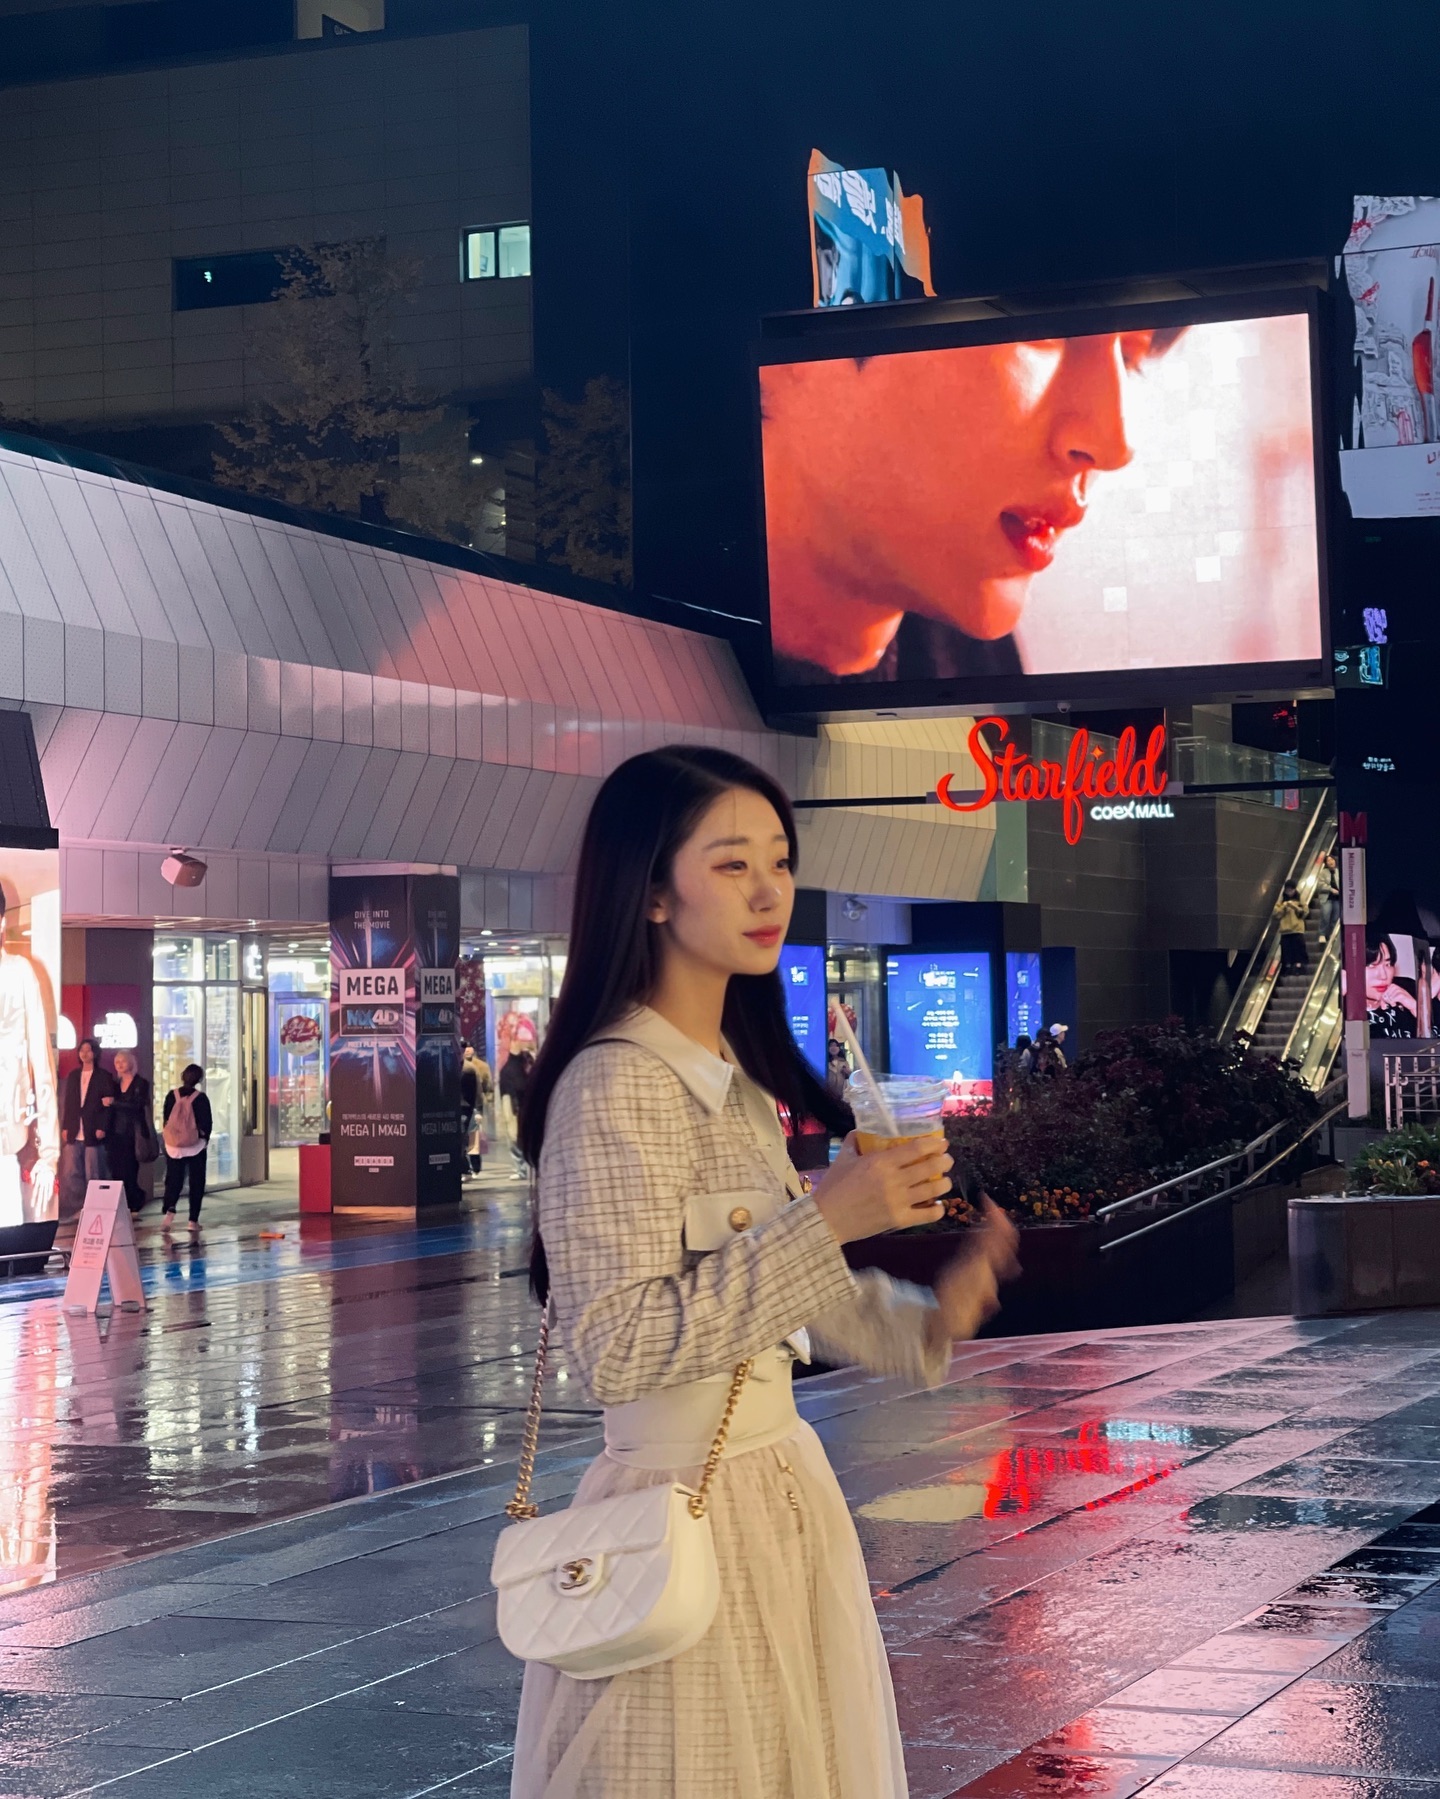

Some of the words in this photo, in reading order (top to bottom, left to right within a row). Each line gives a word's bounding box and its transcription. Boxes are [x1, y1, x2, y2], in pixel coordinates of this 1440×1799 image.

[937, 716, 1167, 845] Starfield
[1136, 804, 1174, 818] MALL
[1347, 889, 1355, 909] Plaza
[354, 910, 371, 919] DIVE
[372, 909, 389, 918] INTO
[353, 921, 366, 929] THE
[369, 920, 391, 929] MOVIE
[346, 976, 399, 996] MEGA
[424, 975, 453, 995] MEGA
[346, 1009, 399, 1028] MX4D
[340, 1124, 369, 1137] MEGA
[378, 1124, 407, 1137] MX4D
